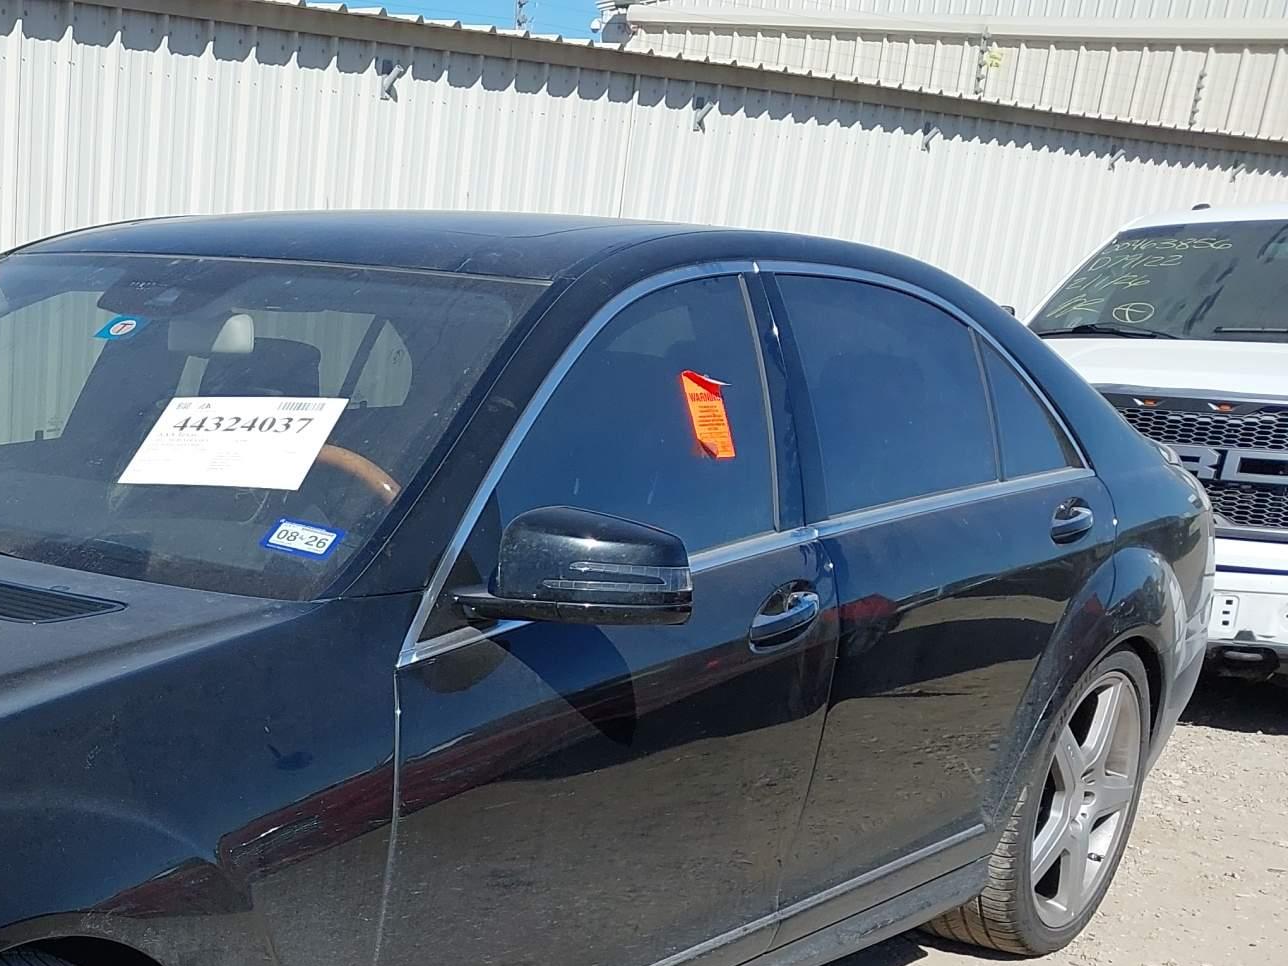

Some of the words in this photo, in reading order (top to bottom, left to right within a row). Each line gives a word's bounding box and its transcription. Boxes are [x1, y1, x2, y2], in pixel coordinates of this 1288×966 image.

[173, 416, 314, 433] 44324037
[276, 529, 300, 542] 08
[304, 535, 329, 549] 26
